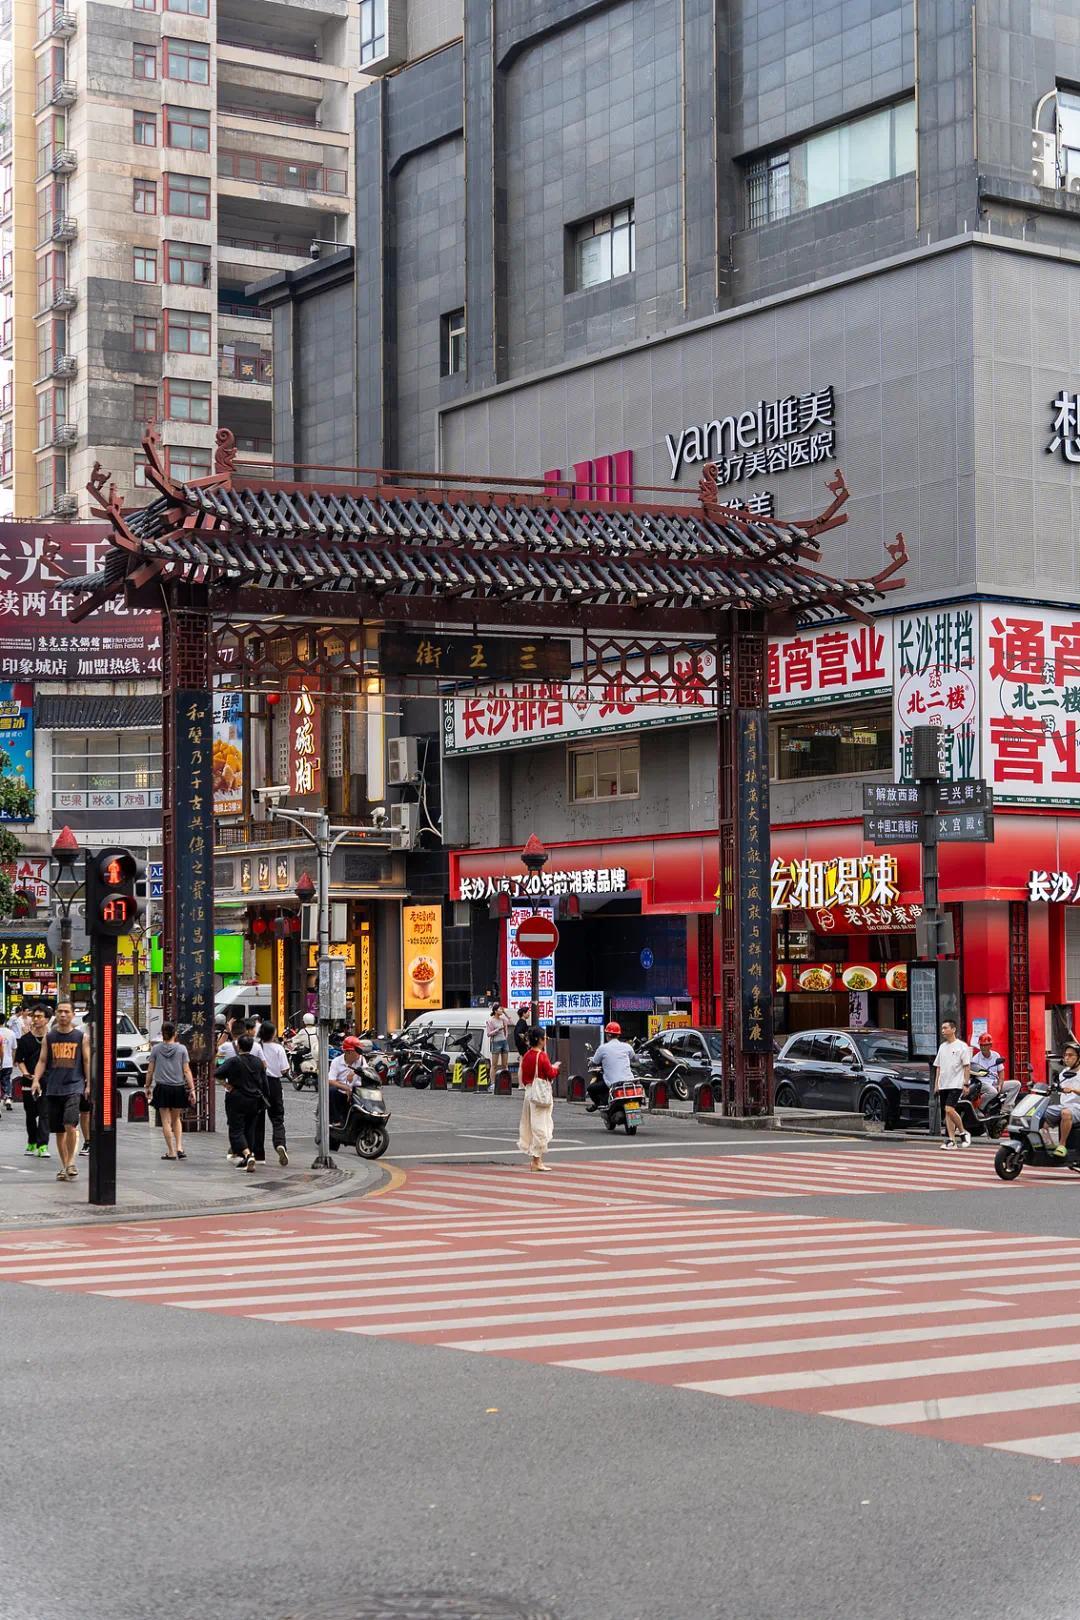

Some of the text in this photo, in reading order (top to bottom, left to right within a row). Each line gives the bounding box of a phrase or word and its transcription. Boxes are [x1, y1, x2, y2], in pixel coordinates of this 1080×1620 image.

[665, 385, 833, 480] yamei 雅美
[2, 658, 67, 675] 印象城店
[906, 685, 966, 715] 北二楼
[1012, 683, 1080, 714] 北二楼
[936, 732, 947, 776] 天心区
[876, 787, 919, 802] 解放西路
[939, 785, 974, 800] 三兴街
[877, 819, 919, 834] 中国工商银行
[939, 816, 975, 833] 火宫殿
[556, 993, 603, 1008] 康辉旅游
